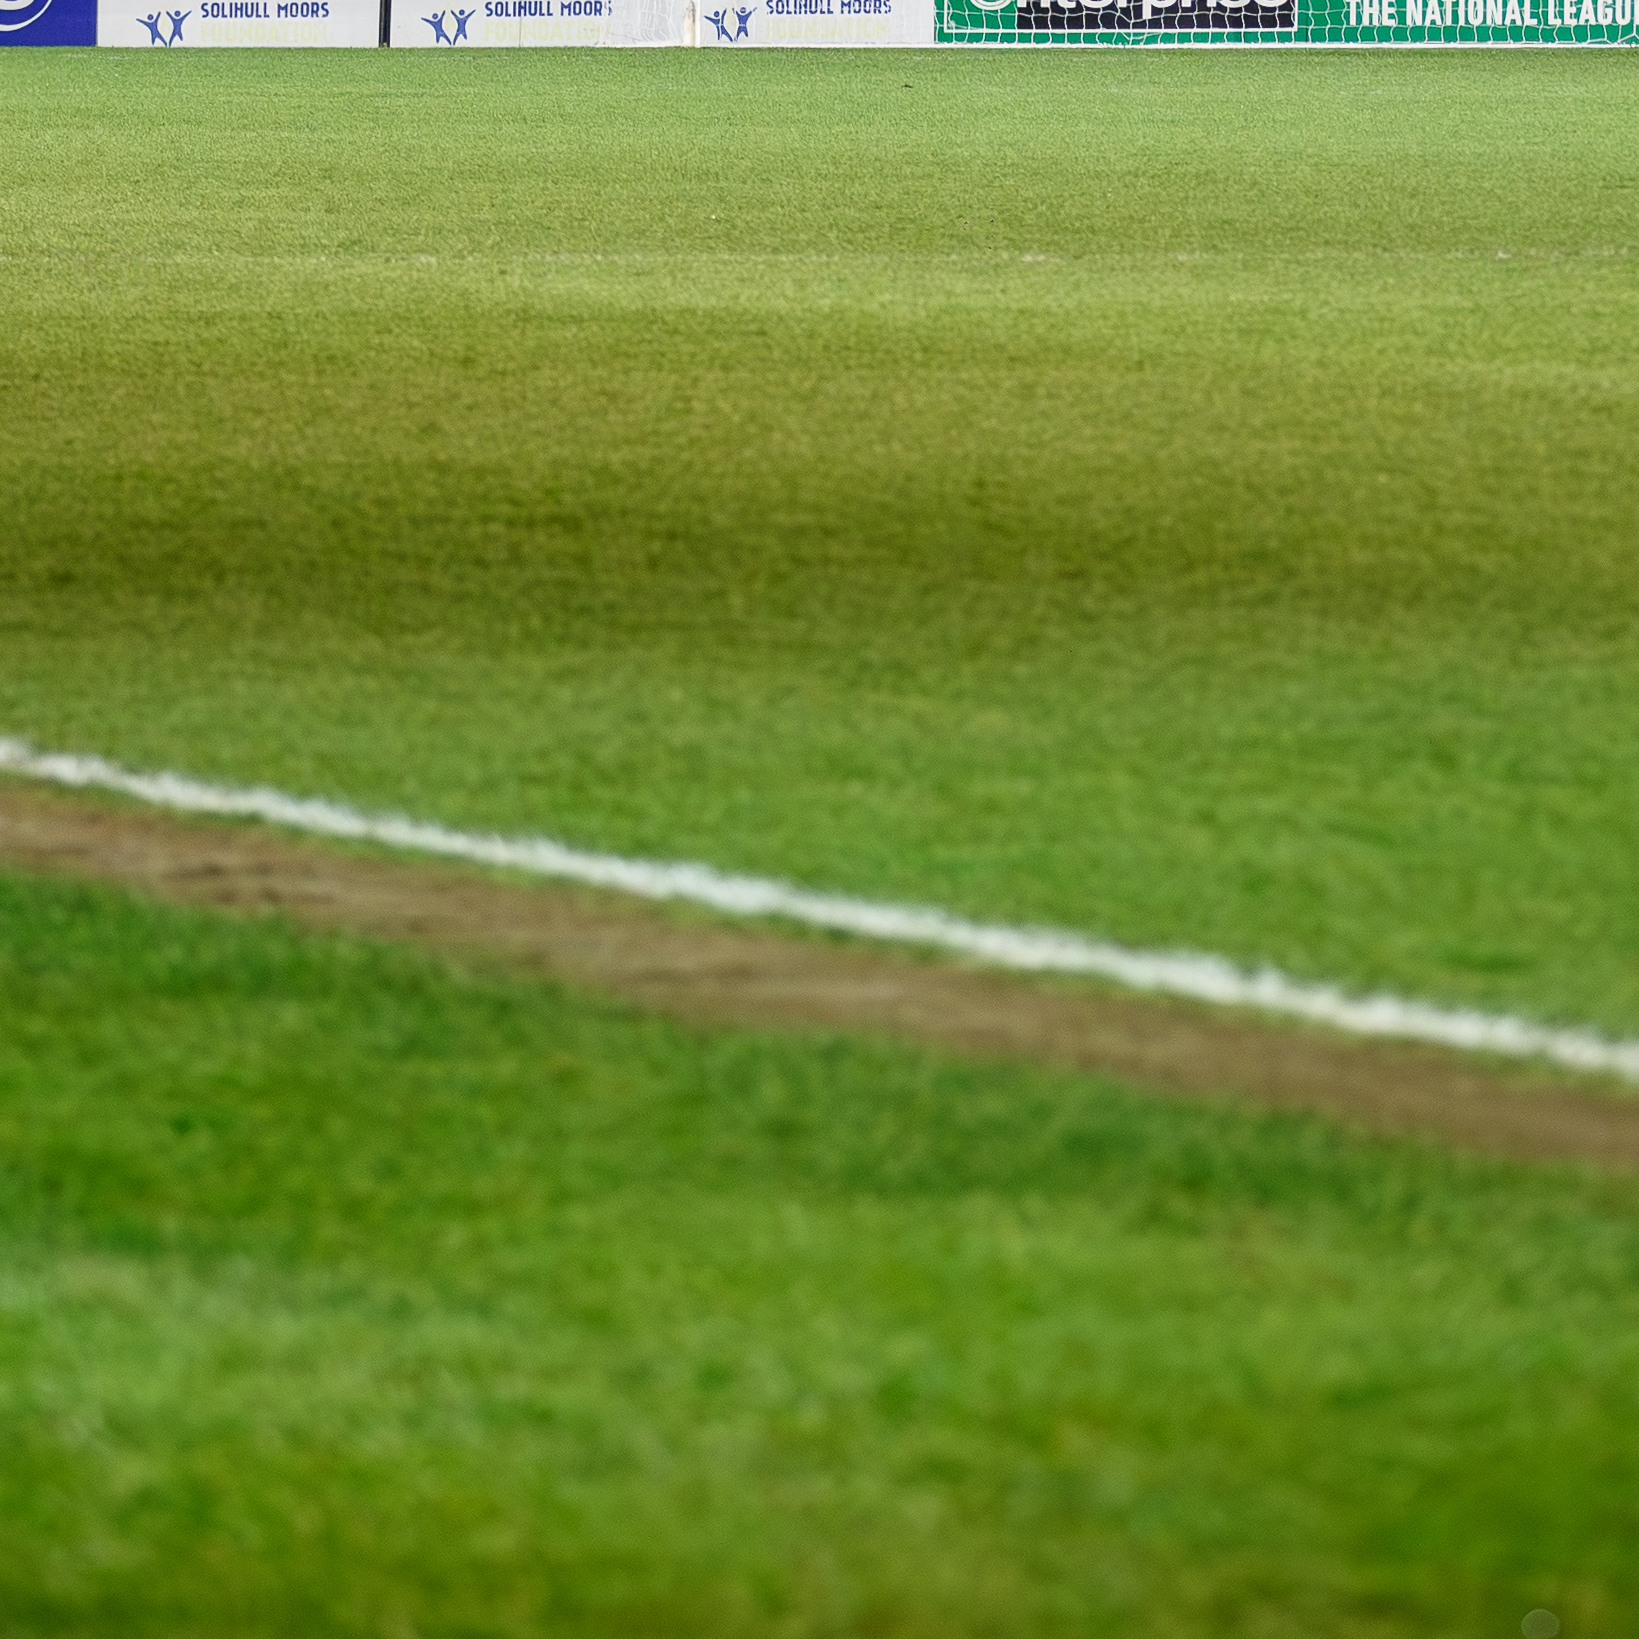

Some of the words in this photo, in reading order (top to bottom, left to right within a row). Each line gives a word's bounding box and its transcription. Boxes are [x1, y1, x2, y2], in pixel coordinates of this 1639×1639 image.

[200, 1, 270, 19] SOLIHULL
[277, 1, 330, 18] MOORS
[484, 0, 554, 18] SOLIHULL
[200, 20, 329, 44] FOUNDATION
